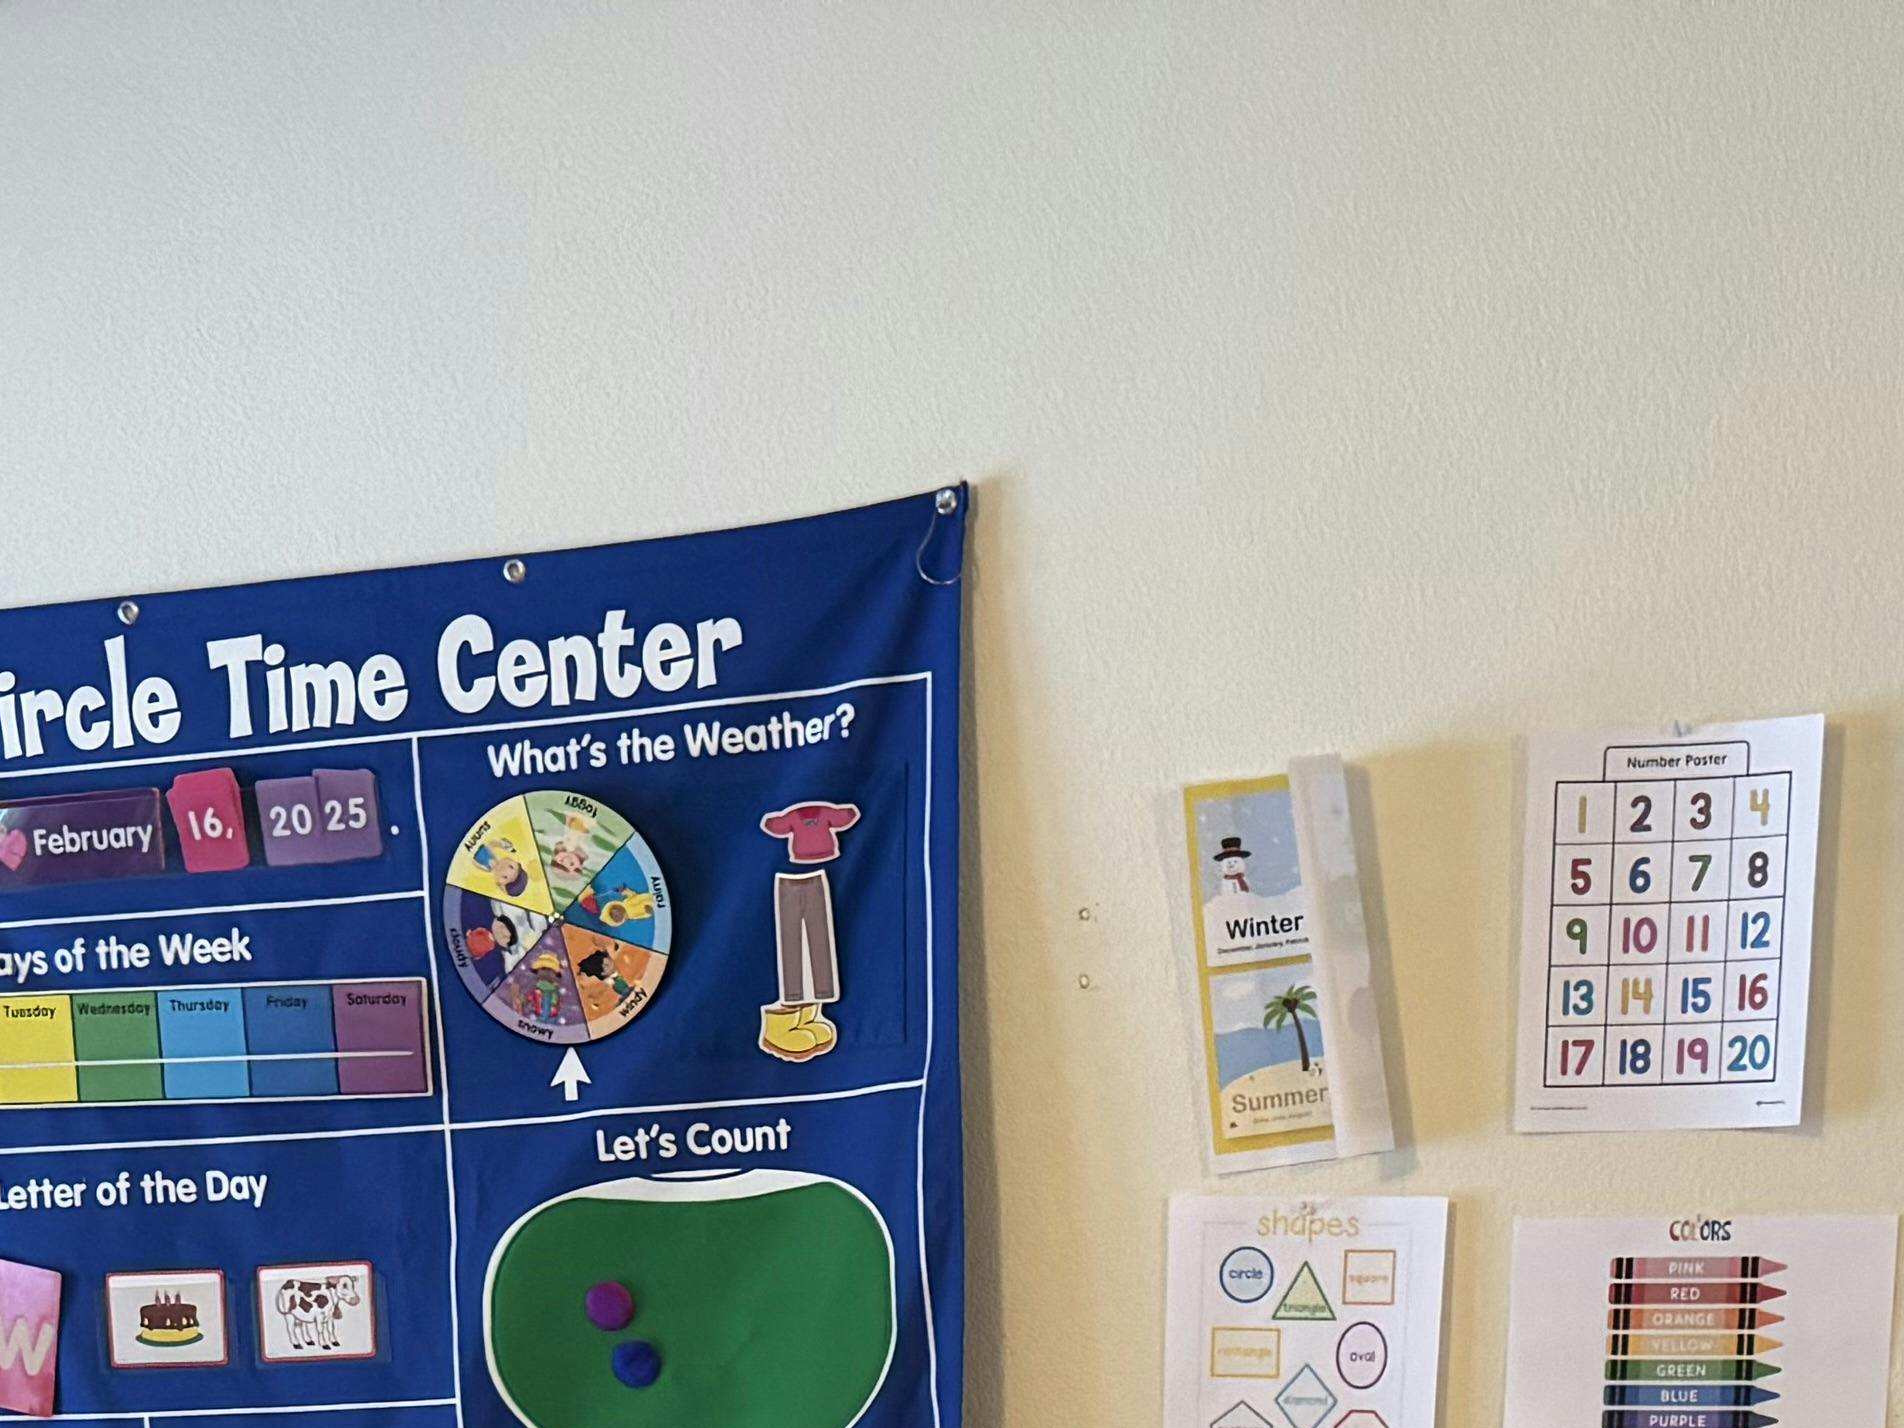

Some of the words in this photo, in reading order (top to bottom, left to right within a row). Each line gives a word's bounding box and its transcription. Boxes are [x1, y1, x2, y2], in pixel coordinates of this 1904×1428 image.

[207, 633, 409, 739] Time
[437, 609, 744, 714] Center
[487, 733, 608, 779] What's
[616, 727, 676, 765] the
[683, 703, 856, 758] Weather?
[1626, 755, 1682, 769] Number
[1685, 753, 1728, 767] Poster
[564, 795, 599, 819] foggy
[1578, 796, 1588, 833] 1
[1629, 794, 1652, 833] 2
[1689, 792, 1712, 830] 3
[1749, 788, 1771, 827] 4
[32, 824, 153, 856] February
[464, 821, 492, 852] sunny
[1570, 858, 1593, 896] 5
[1629, 856, 1652, 894] 6
[1688, 854, 1713, 892] 7
[1748, 851, 1769, 888] 8
[650, 876, 666, 909] rainy
[1225, 914, 1305, 940] Winter
[1565, 917, 1588, 955] 9
[1622, 917, 1658, 954] 10
[1685, 914, 1710, 952] 11
[1740, 911, 1771, 950] 12
[53, 937, 87, 974] of
[95, 935, 150, 971] the
[158, 927, 253, 967] Week
[449, 927, 470, 969] cloudy
[169, 999, 231, 1013] Thursday
[265, 994, 309, 1009] Friday
[345, 991, 408, 1007] Saturday
[620, 987, 648, 1018] windy
[1562, 979, 1594, 1016] 13
[1621, 977, 1654, 1015] 14
[1681, 977, 1712, 1014] 15
[1738, 973, 1768, 1012] 16
[3, 1005, 57, 1020] Tuesday
[77, 1002, 151, 1017] Wednesday
[517, 1018, 554, 1040] snowy
[1560, 1039, 1595, 1076] 17
[1619, 1038, 1652, 1075] 18
[1676, 1037, 1709, 1075] 19
[1727, 1034, 1771, 1072] 20
[1232, 1086, 1329, 1114] Summer
[596, 1123, 678, 1162] Let's
[686, 1118, 792, 1156] Count
[96, 1171, 132, 1206] of
[139, 1170, 198, 1206] the
[205, 1169, 269, 1208] Day
[1257, 1208, 1360, 1245] shapes
[1669, 1219, 1732, 1241] COLORS
[1228, 1267, 1263, 1280] circle
[1668, 1262, 1705, 1274] PINK
[1670, 1287, 1701, 1300] RED
[1283, 1302, 1327, 1316] triangle
[1652, 1313, 1716, 1327] ORANGE
[1349, 1351, 1376, 1363] oval
[1656, 1364, 1707, 1377] GREEN
[1660, 1389, 1699, 1403] BLUE
[1649, 1414, 1707, 1428] PURPLE
